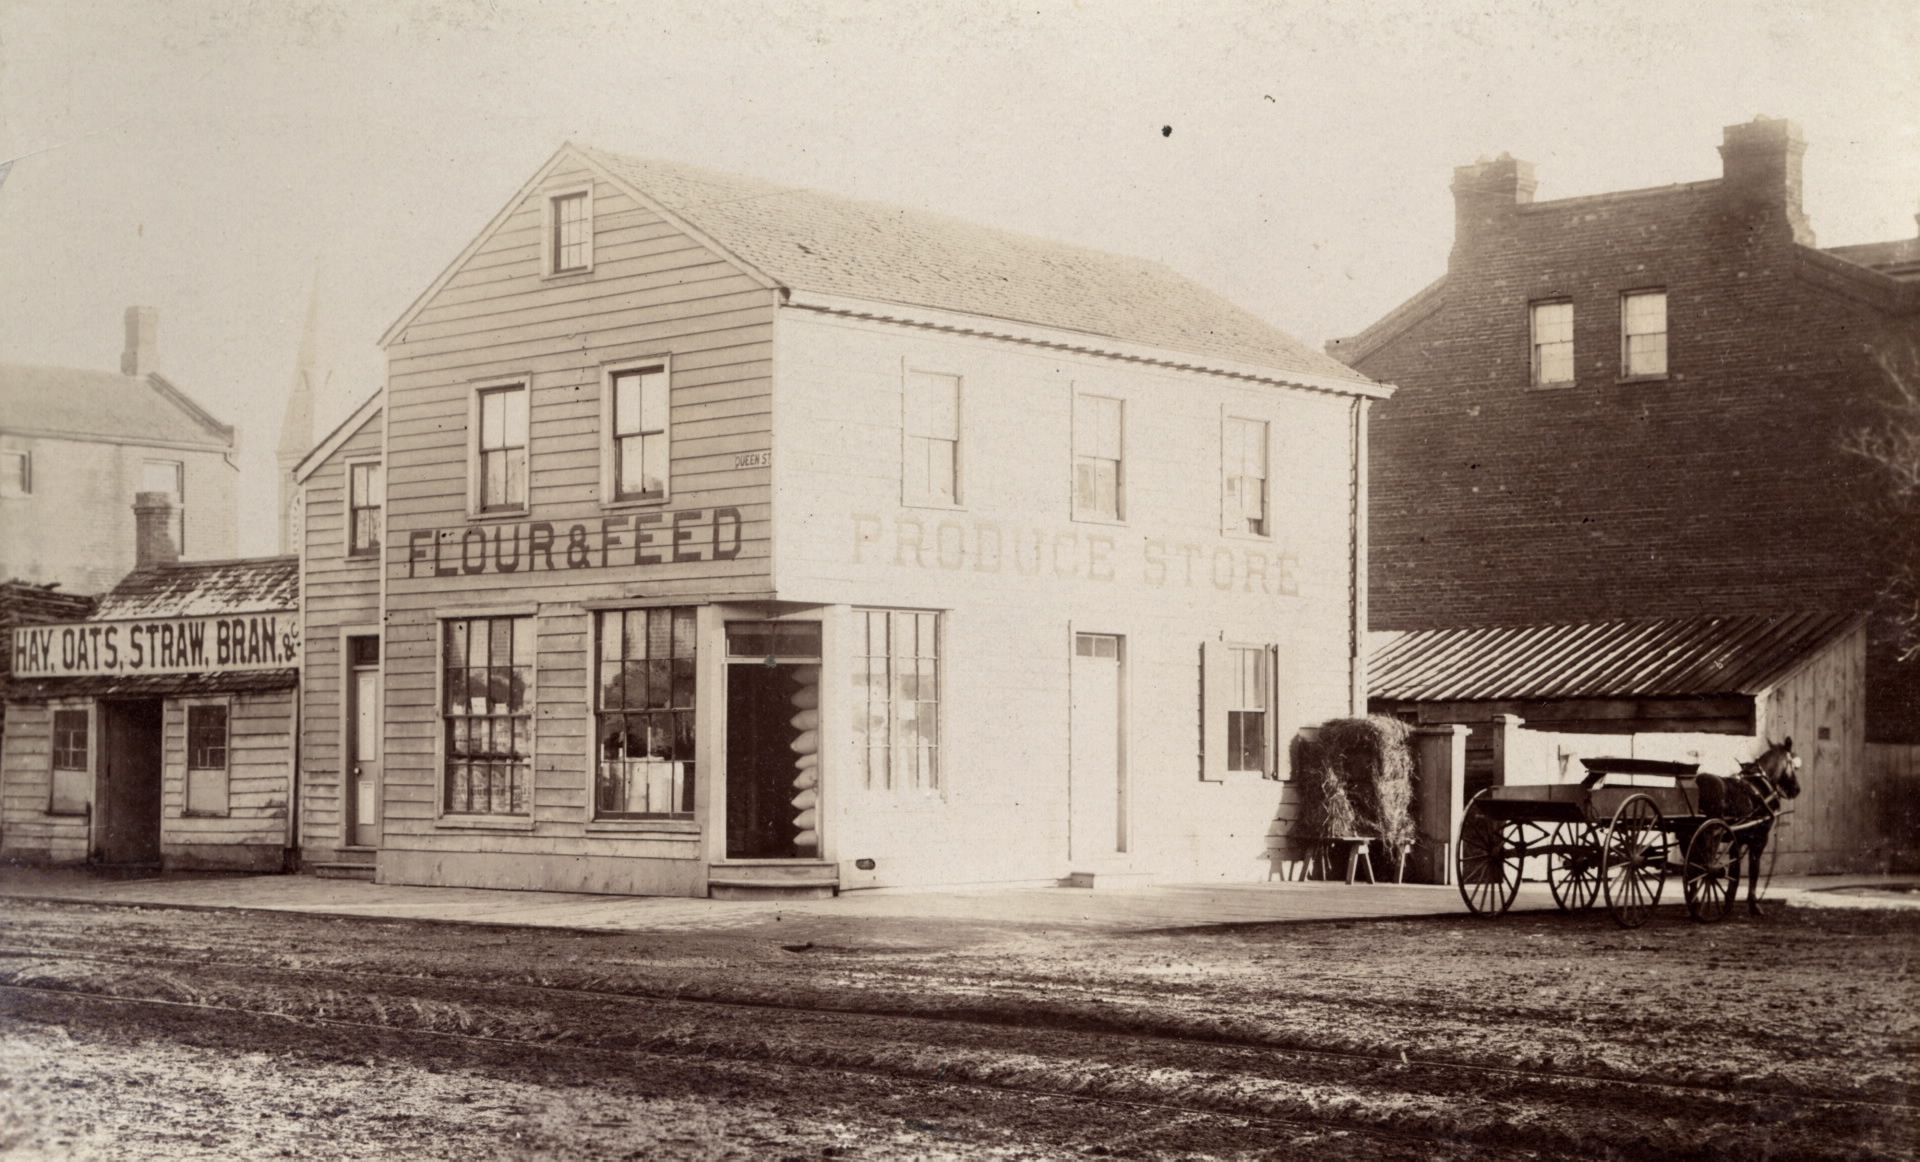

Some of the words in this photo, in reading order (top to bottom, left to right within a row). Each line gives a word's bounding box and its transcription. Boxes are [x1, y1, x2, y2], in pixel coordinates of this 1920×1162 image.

[735, 453, 760, 468] QUEEN
[408, 521, 555, 579] FLOUR
[566, 523, 591, 570] &
[602, 507, 742, 568] FEED
[850, 512, 1116, 582] PRODUCE
[1143, 539, 1301, 598] STORE
[15, 629, 55, 673] HAY,
[62, 625, 124, 671] OATS,
[129, 621, 209, 669] STRAW,
